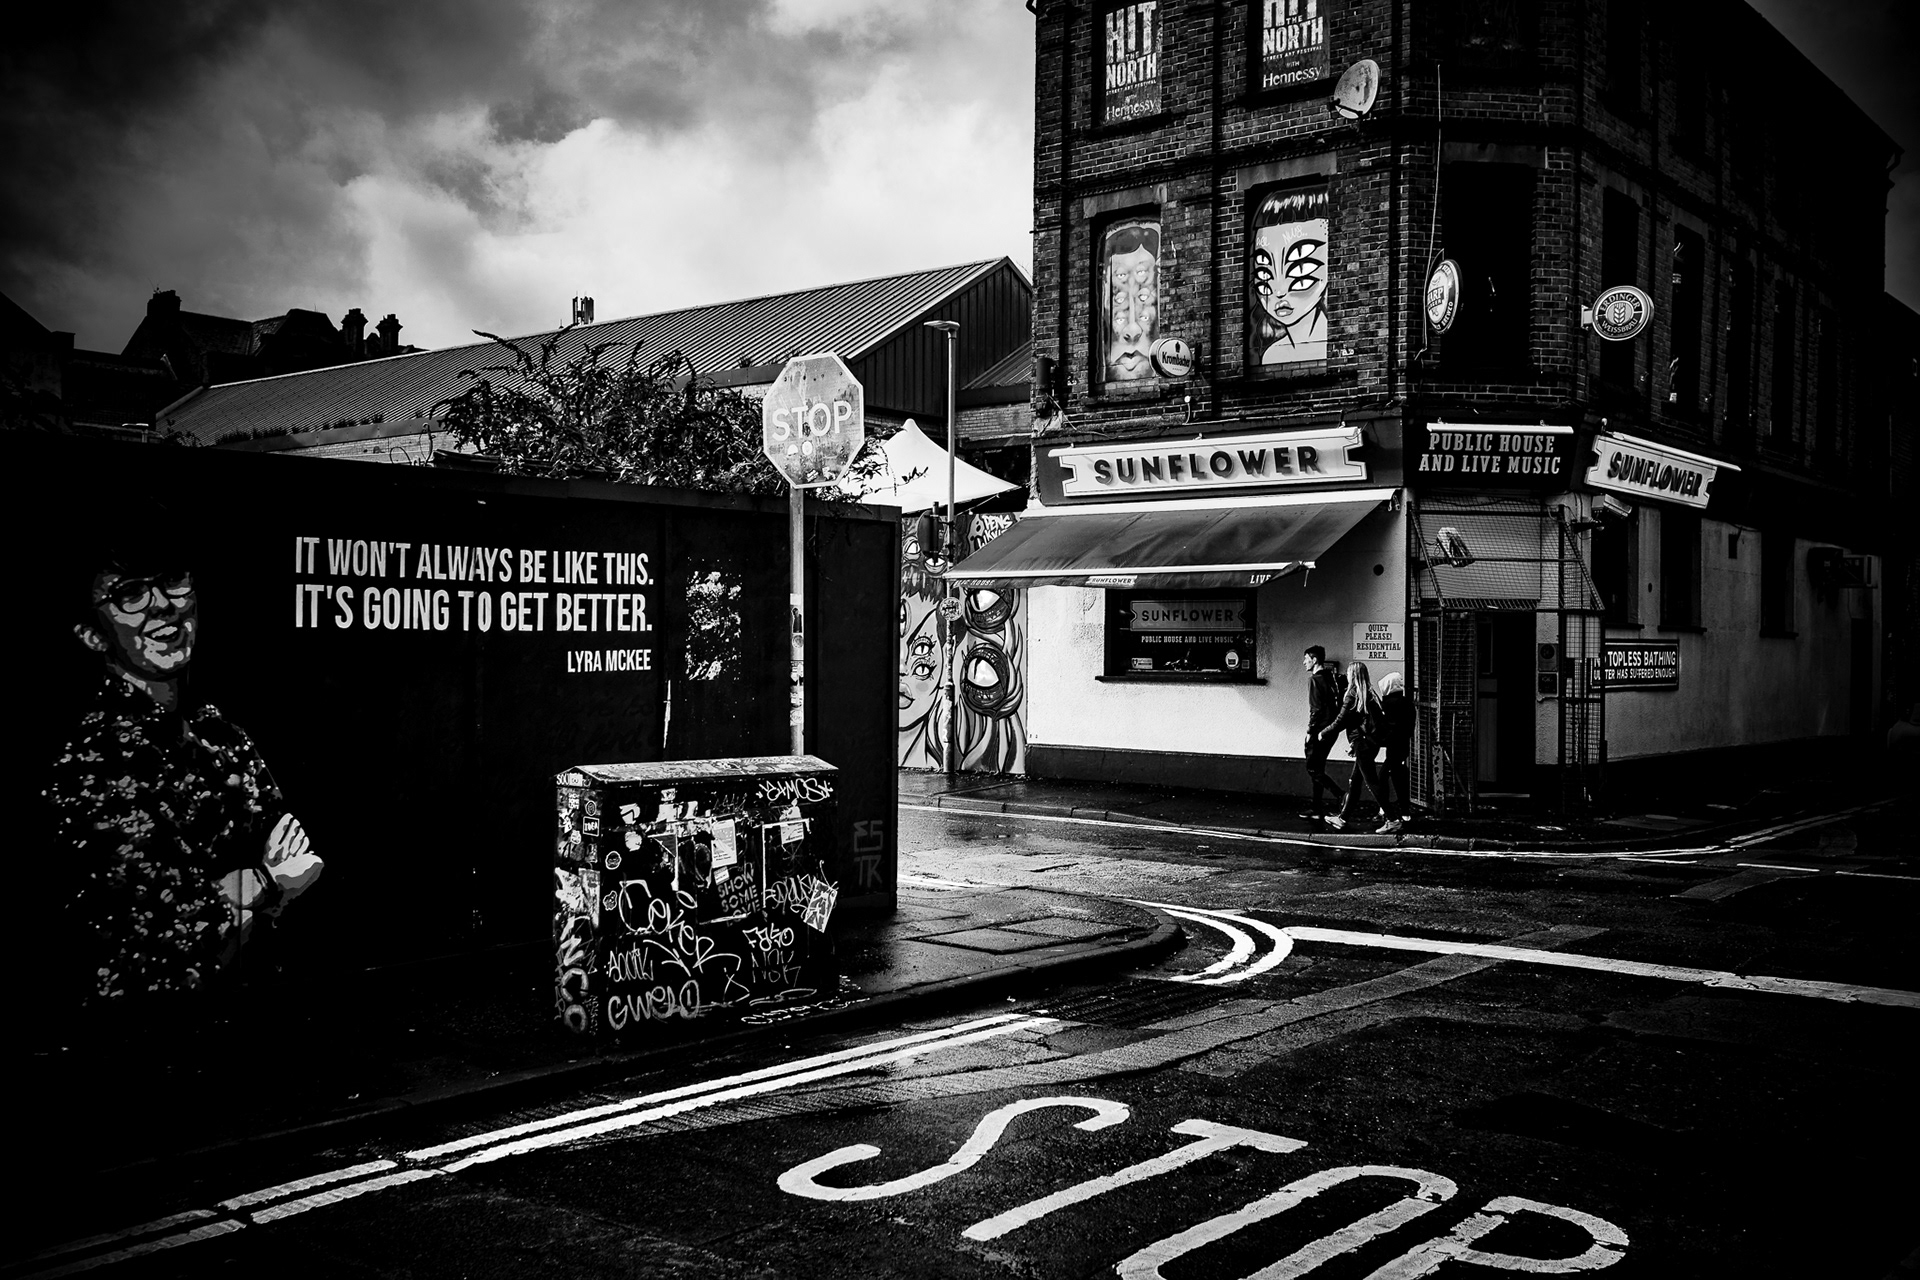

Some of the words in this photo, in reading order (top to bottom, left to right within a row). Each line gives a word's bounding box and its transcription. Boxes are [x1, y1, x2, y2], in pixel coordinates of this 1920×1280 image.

[1286, 15, 1303, 25] THE
[1105, 1, 1157, 64] HIT
[1262, 16, 1324, 56] NORTH
[1105, 52, 1157, 90] NORTH
[1262, 66, 1323, 88] Hennessy
[1106, 99, 1156, 121] Hennessy
[1599, 293, 1641, 311] ERDINGER
[772, 400, 852, 441] STOP
[1429, 433, 1493, 451] PUBLIC
[1499, 434, 1555, 453] HOUSE
[1093, 446, 1320, 484] SUNFLOWER
[1418, 454, 1455, 472] AND
[1461, 455, 1501, 473] LIVE
[1507, 456, 1561, 474] MUSIC
[1607, 451, 1703, 497] SUNFLOWER
[295, 536, 320, 574] IT
[327, 538, 411, 578] WON'T
[416, 543, 513, 582] ALWAYS
[519, 549, 547, 583] BE
[552, 550, 598, 585] LIKE
[603, 552, 654, 585] THIS.
[1092, 577, 1132, 585] SUNFLOWER
[295, 584, 354, 629] IT'S
[363, 586, 450, 631] GOING
[457, 590, 492, 632] TO
[500, 591, 549, 632] GET
[556, 593, 653, 632] BETTER.
[1141, 609, 1234, 622] SUNFLOWER
[1141, 635, 1162, 643] PUBLIC
[1163, 635, 1183, 643] HOUSE
[1184, 635, 1197, 643] AND
[1198, 635, 1213, 643] LIVE
[1214, 635, 1234, 643] MUSIC
[1365, 632, 1392, 640] PLEASE!
[1368, 624, 1389, 632] QUIET
[567, 650, 602, 673] LYRA
[605, 649, 652, 672] MCKEE
[1368, 651, 1389, 659] AREA.
[1607, 651, 1642, 667] TOPLESS
[1643, 650, 1676, 666] BATHING
[1616, 668, 1629, 679] HAS
[1629, 668, 1655, 679] SUFFERED
[1655, 667, 1677, 678] ENOUGH
[717, 872, 754, 898] SHOW
[721, 884, 758, 912] SOME
[776, 1095, 1631, 1280] STOP
